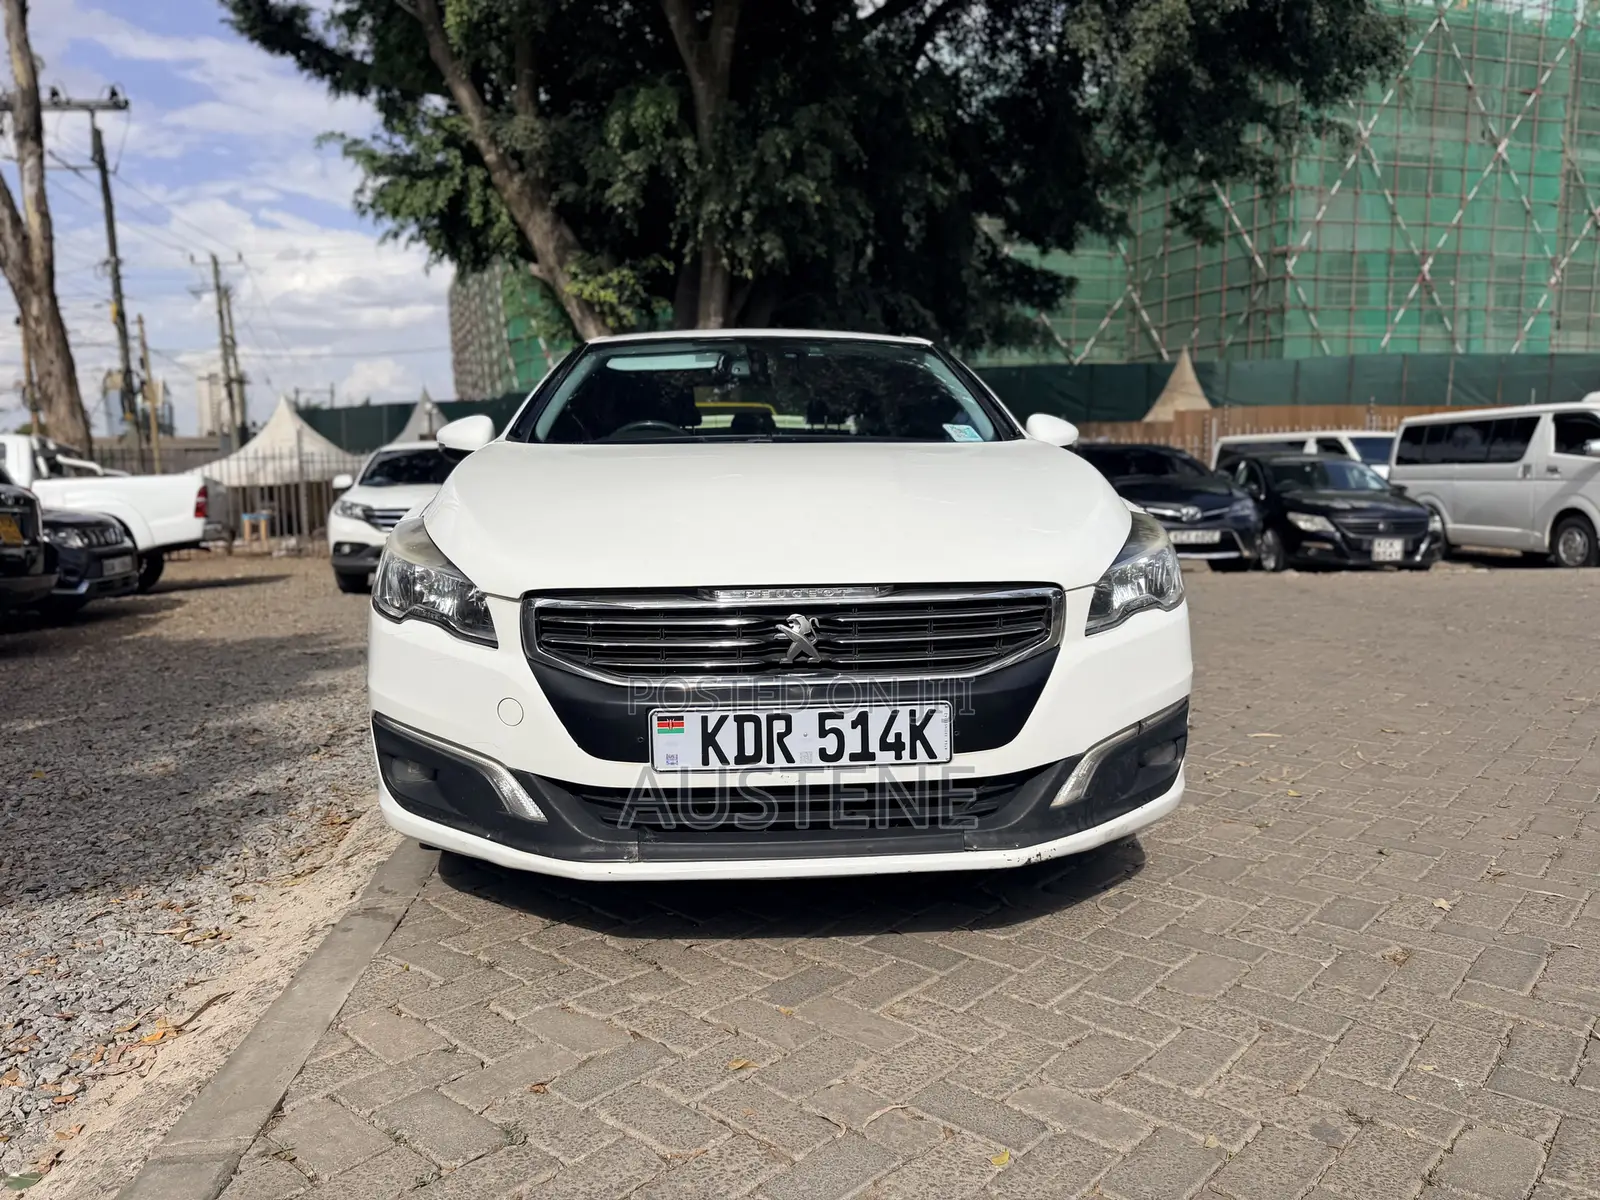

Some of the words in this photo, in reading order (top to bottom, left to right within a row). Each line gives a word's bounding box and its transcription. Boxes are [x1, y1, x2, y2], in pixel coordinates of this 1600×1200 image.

[745, 588, 848, 600] PEUGEOT
[700, 711, 796, 766] KDR
[817, 707, 938, 764] 514K
